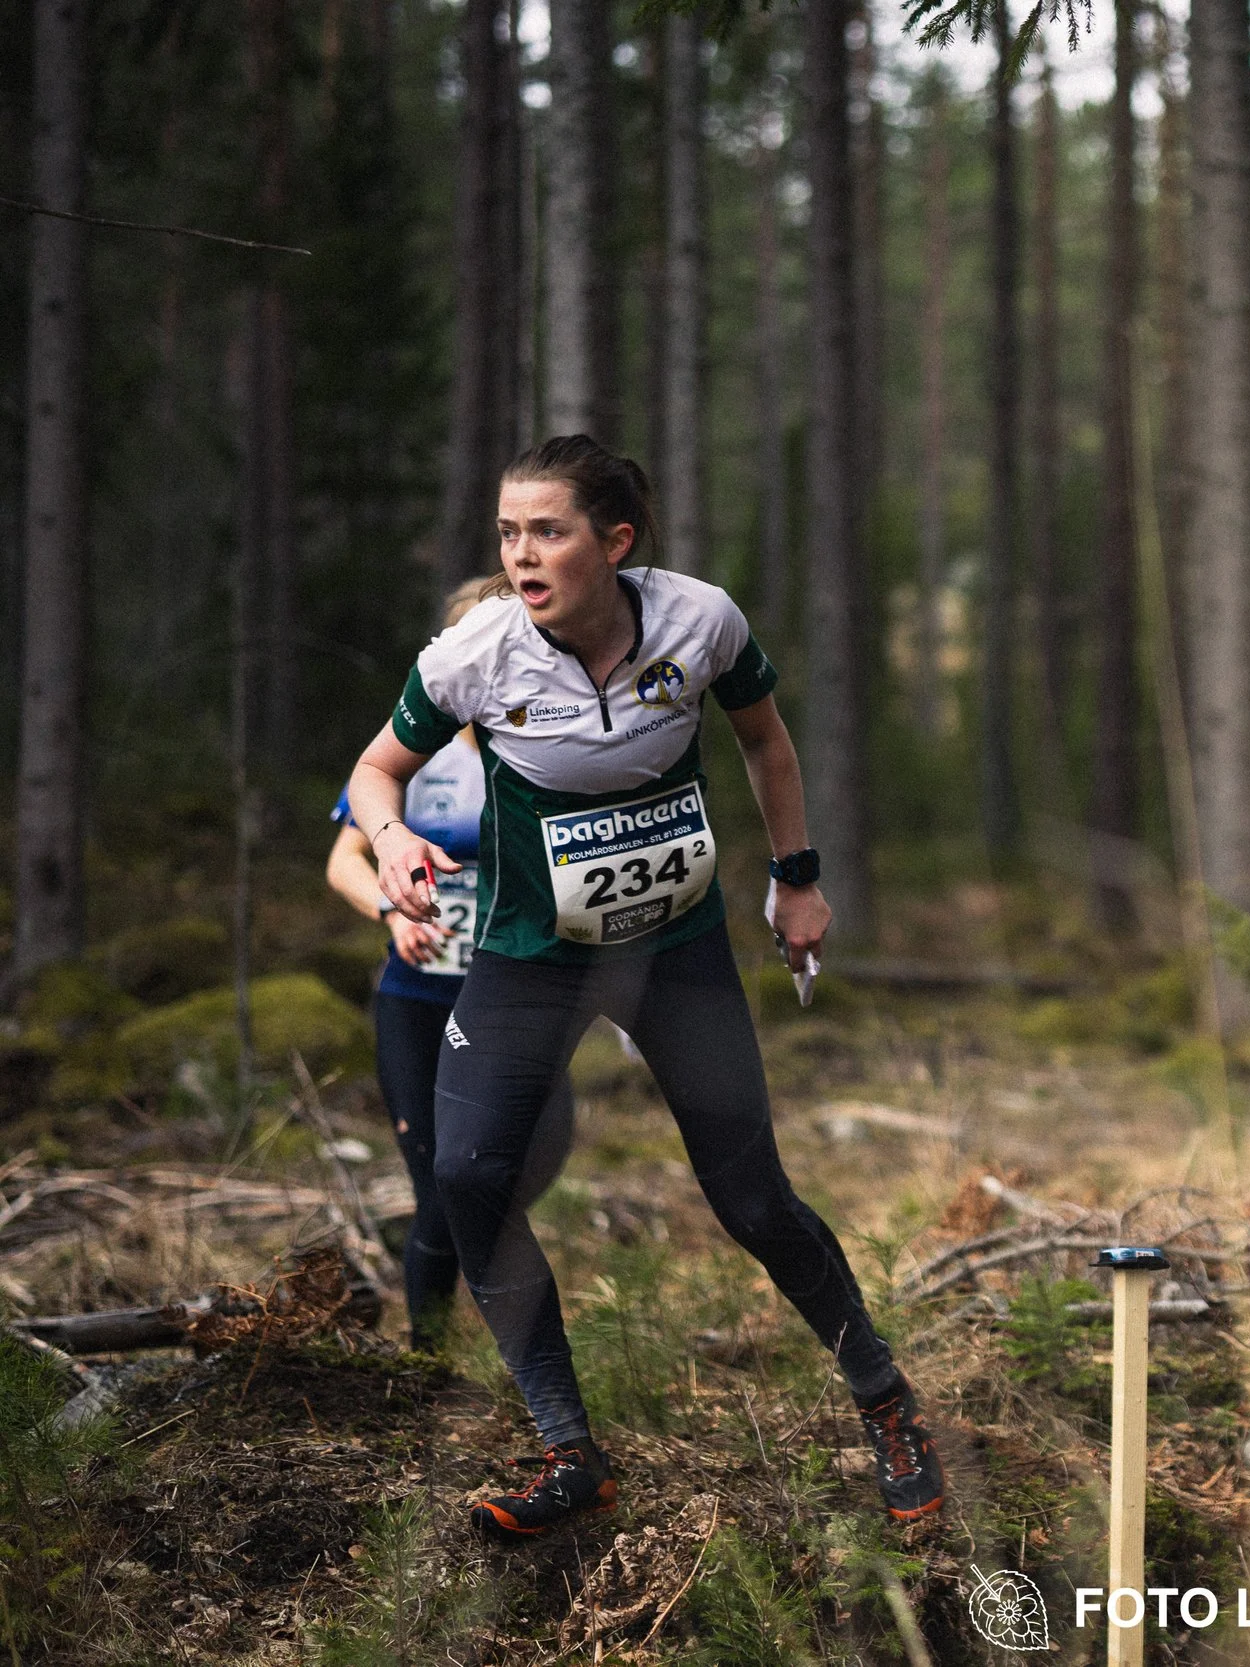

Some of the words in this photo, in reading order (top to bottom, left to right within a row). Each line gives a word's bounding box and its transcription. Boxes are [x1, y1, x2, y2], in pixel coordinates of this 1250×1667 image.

[530, 705, 580, 716] Linköping
[549, 794, 699, 847] bagheera
[568, 840, 644, 861] KOLMÅRDSKAVLEN
[650, 836, 663, 844] STL
[674, 825, 692, 837] 2026
[583, 847, 690, 909] 234
[693, 840, 707, 858] 2
[608, 902, 666, 923] GODKÄNDA
